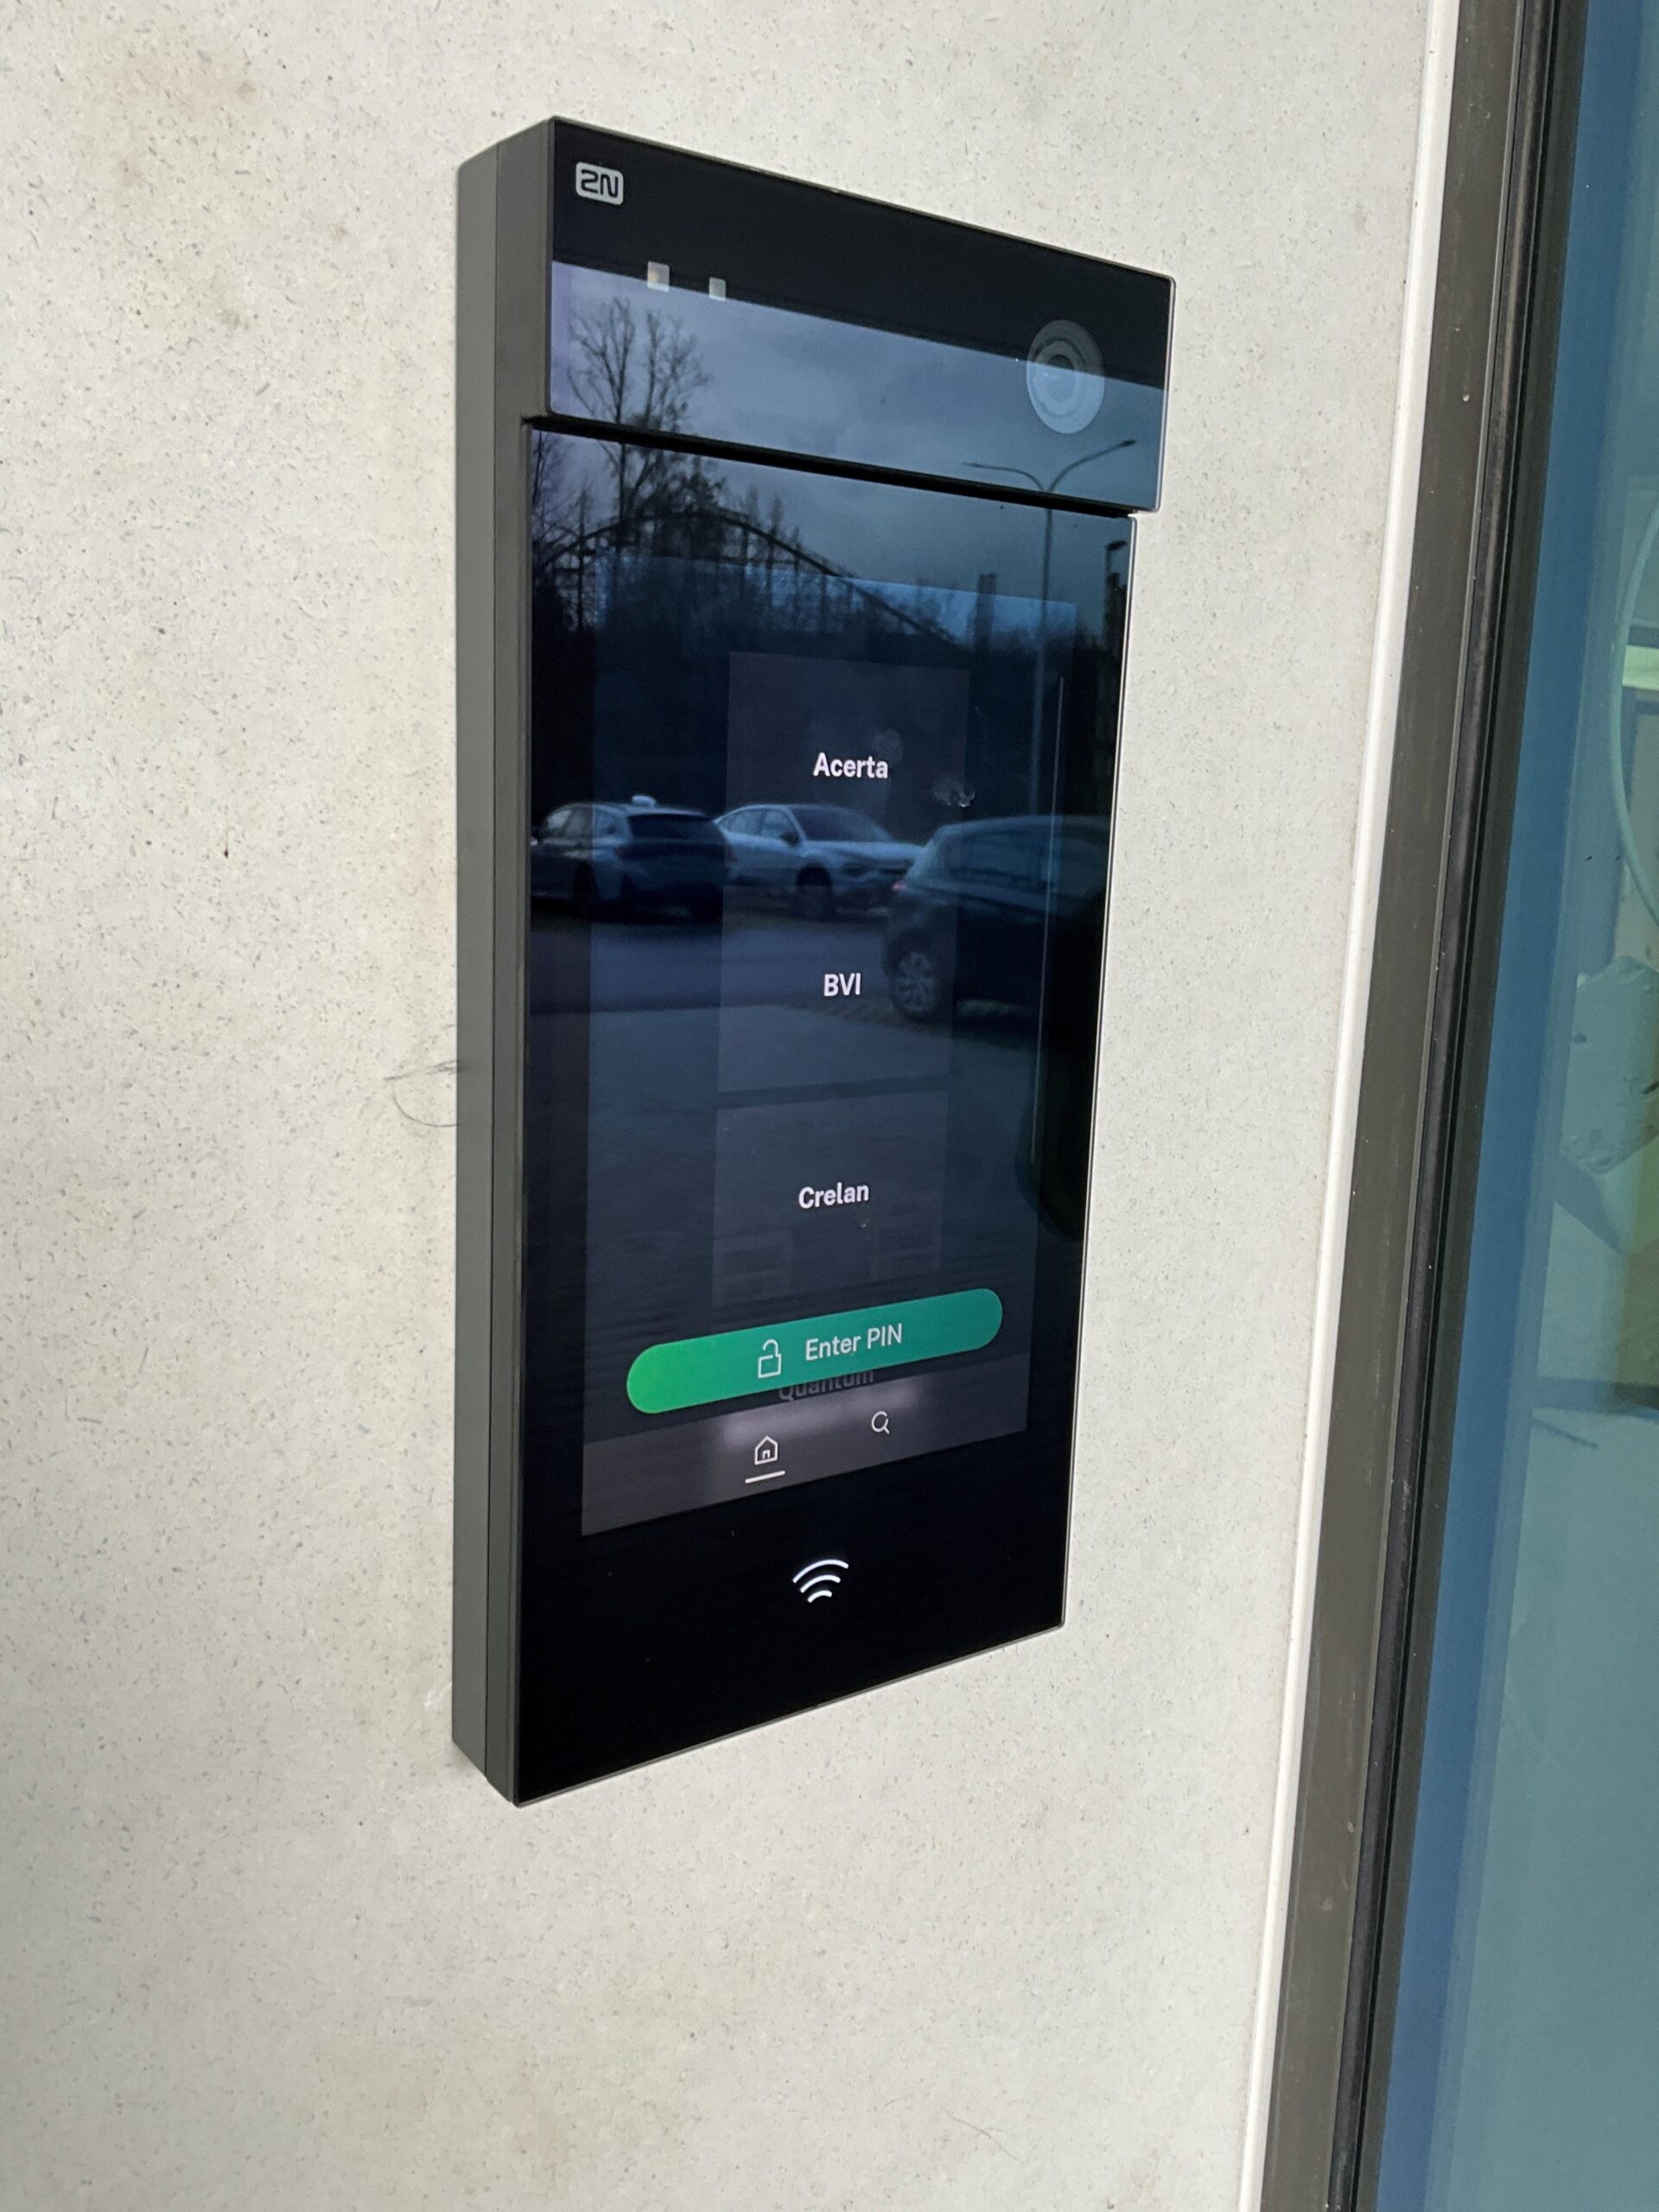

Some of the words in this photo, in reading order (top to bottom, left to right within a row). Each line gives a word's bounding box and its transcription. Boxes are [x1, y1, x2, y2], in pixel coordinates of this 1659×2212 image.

[580, 167, 620, 200] 2N
[813, 752, 888, 779] Acerta
[823, 972, 861, 997] BVI
[798, 1181, 869, 1209] Crelan
[805, 1336, 861, 1362] Enter
[867, 1322, 903, 1350] PIN
